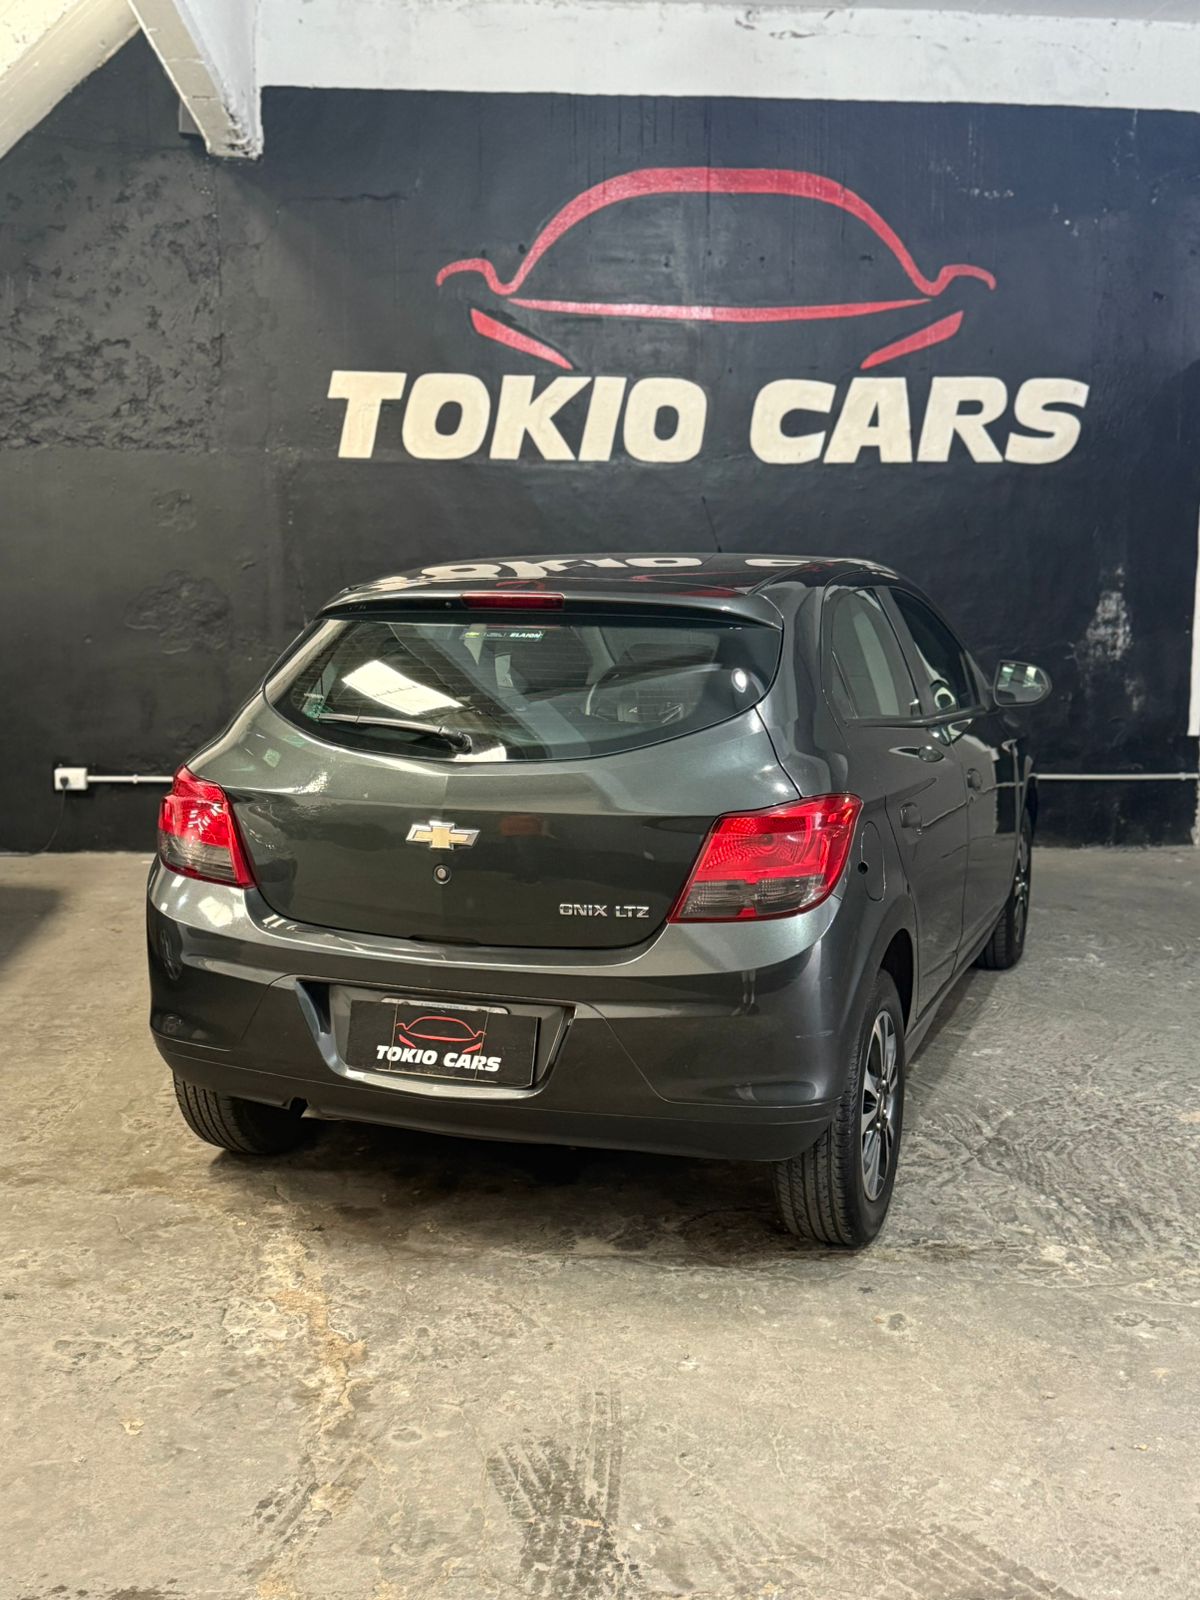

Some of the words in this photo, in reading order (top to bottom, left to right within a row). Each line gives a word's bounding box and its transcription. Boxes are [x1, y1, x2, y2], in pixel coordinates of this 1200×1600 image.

[327, 370, 707, 463] TOKIO
[750, 376, 1090, 465] CARS
[559, 903, 608, 917] ONIX
[615, 905, 650, 918] LTZ
[376, 1045, 438, 1065] TOKIO
[443, 1052, 502, 1073] CARS
